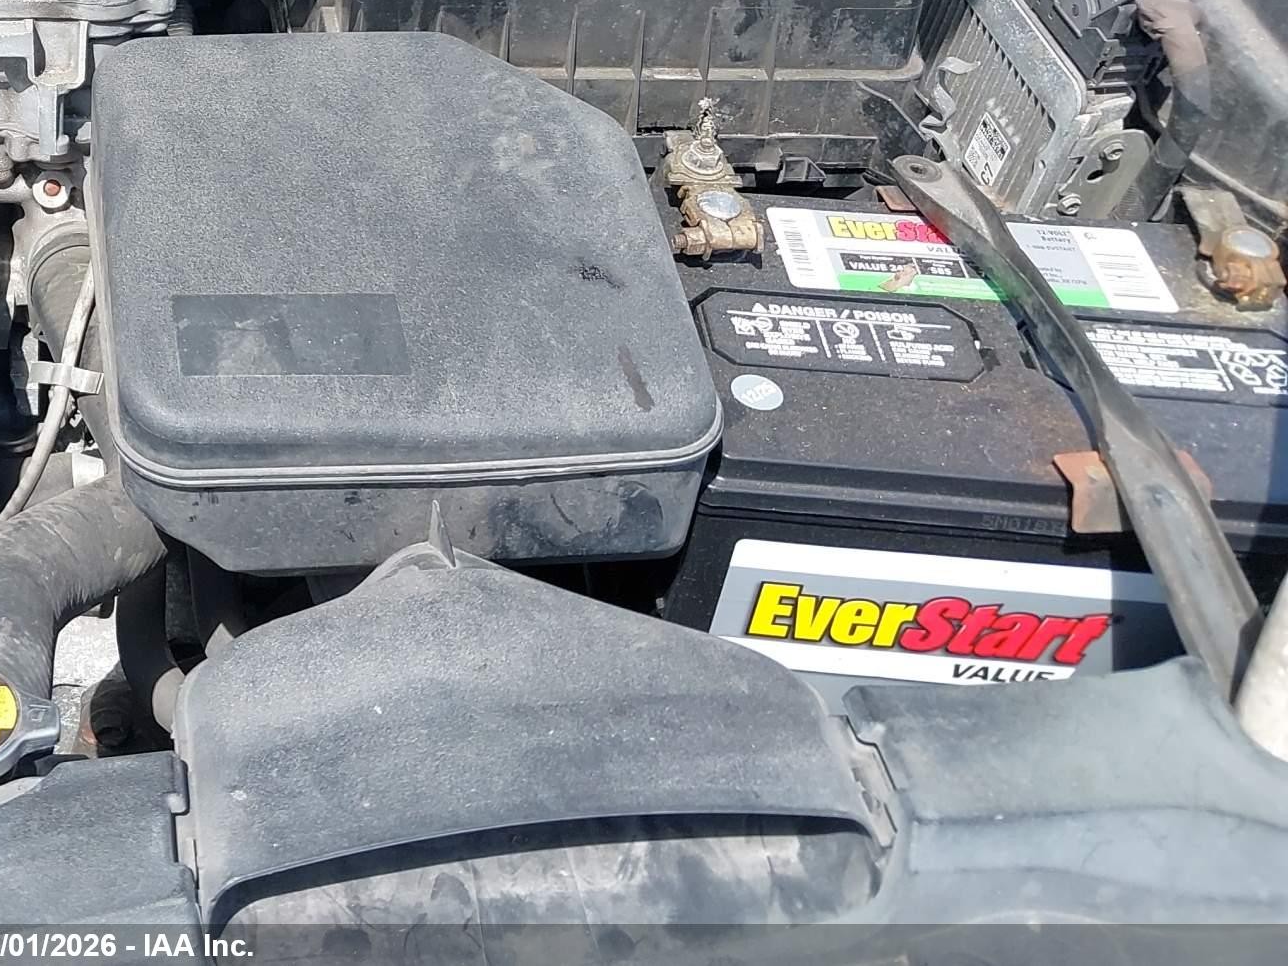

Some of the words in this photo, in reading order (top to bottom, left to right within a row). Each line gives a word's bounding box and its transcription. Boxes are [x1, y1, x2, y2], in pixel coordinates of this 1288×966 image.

[825, 215, 953, 245] EverSta
[848, 260, 888, 272] VALUE
[768, 303, 838, 319] DANGER
[852, 309, 917, 324] POISON
[747, 581, 1112, 665] EverStart
